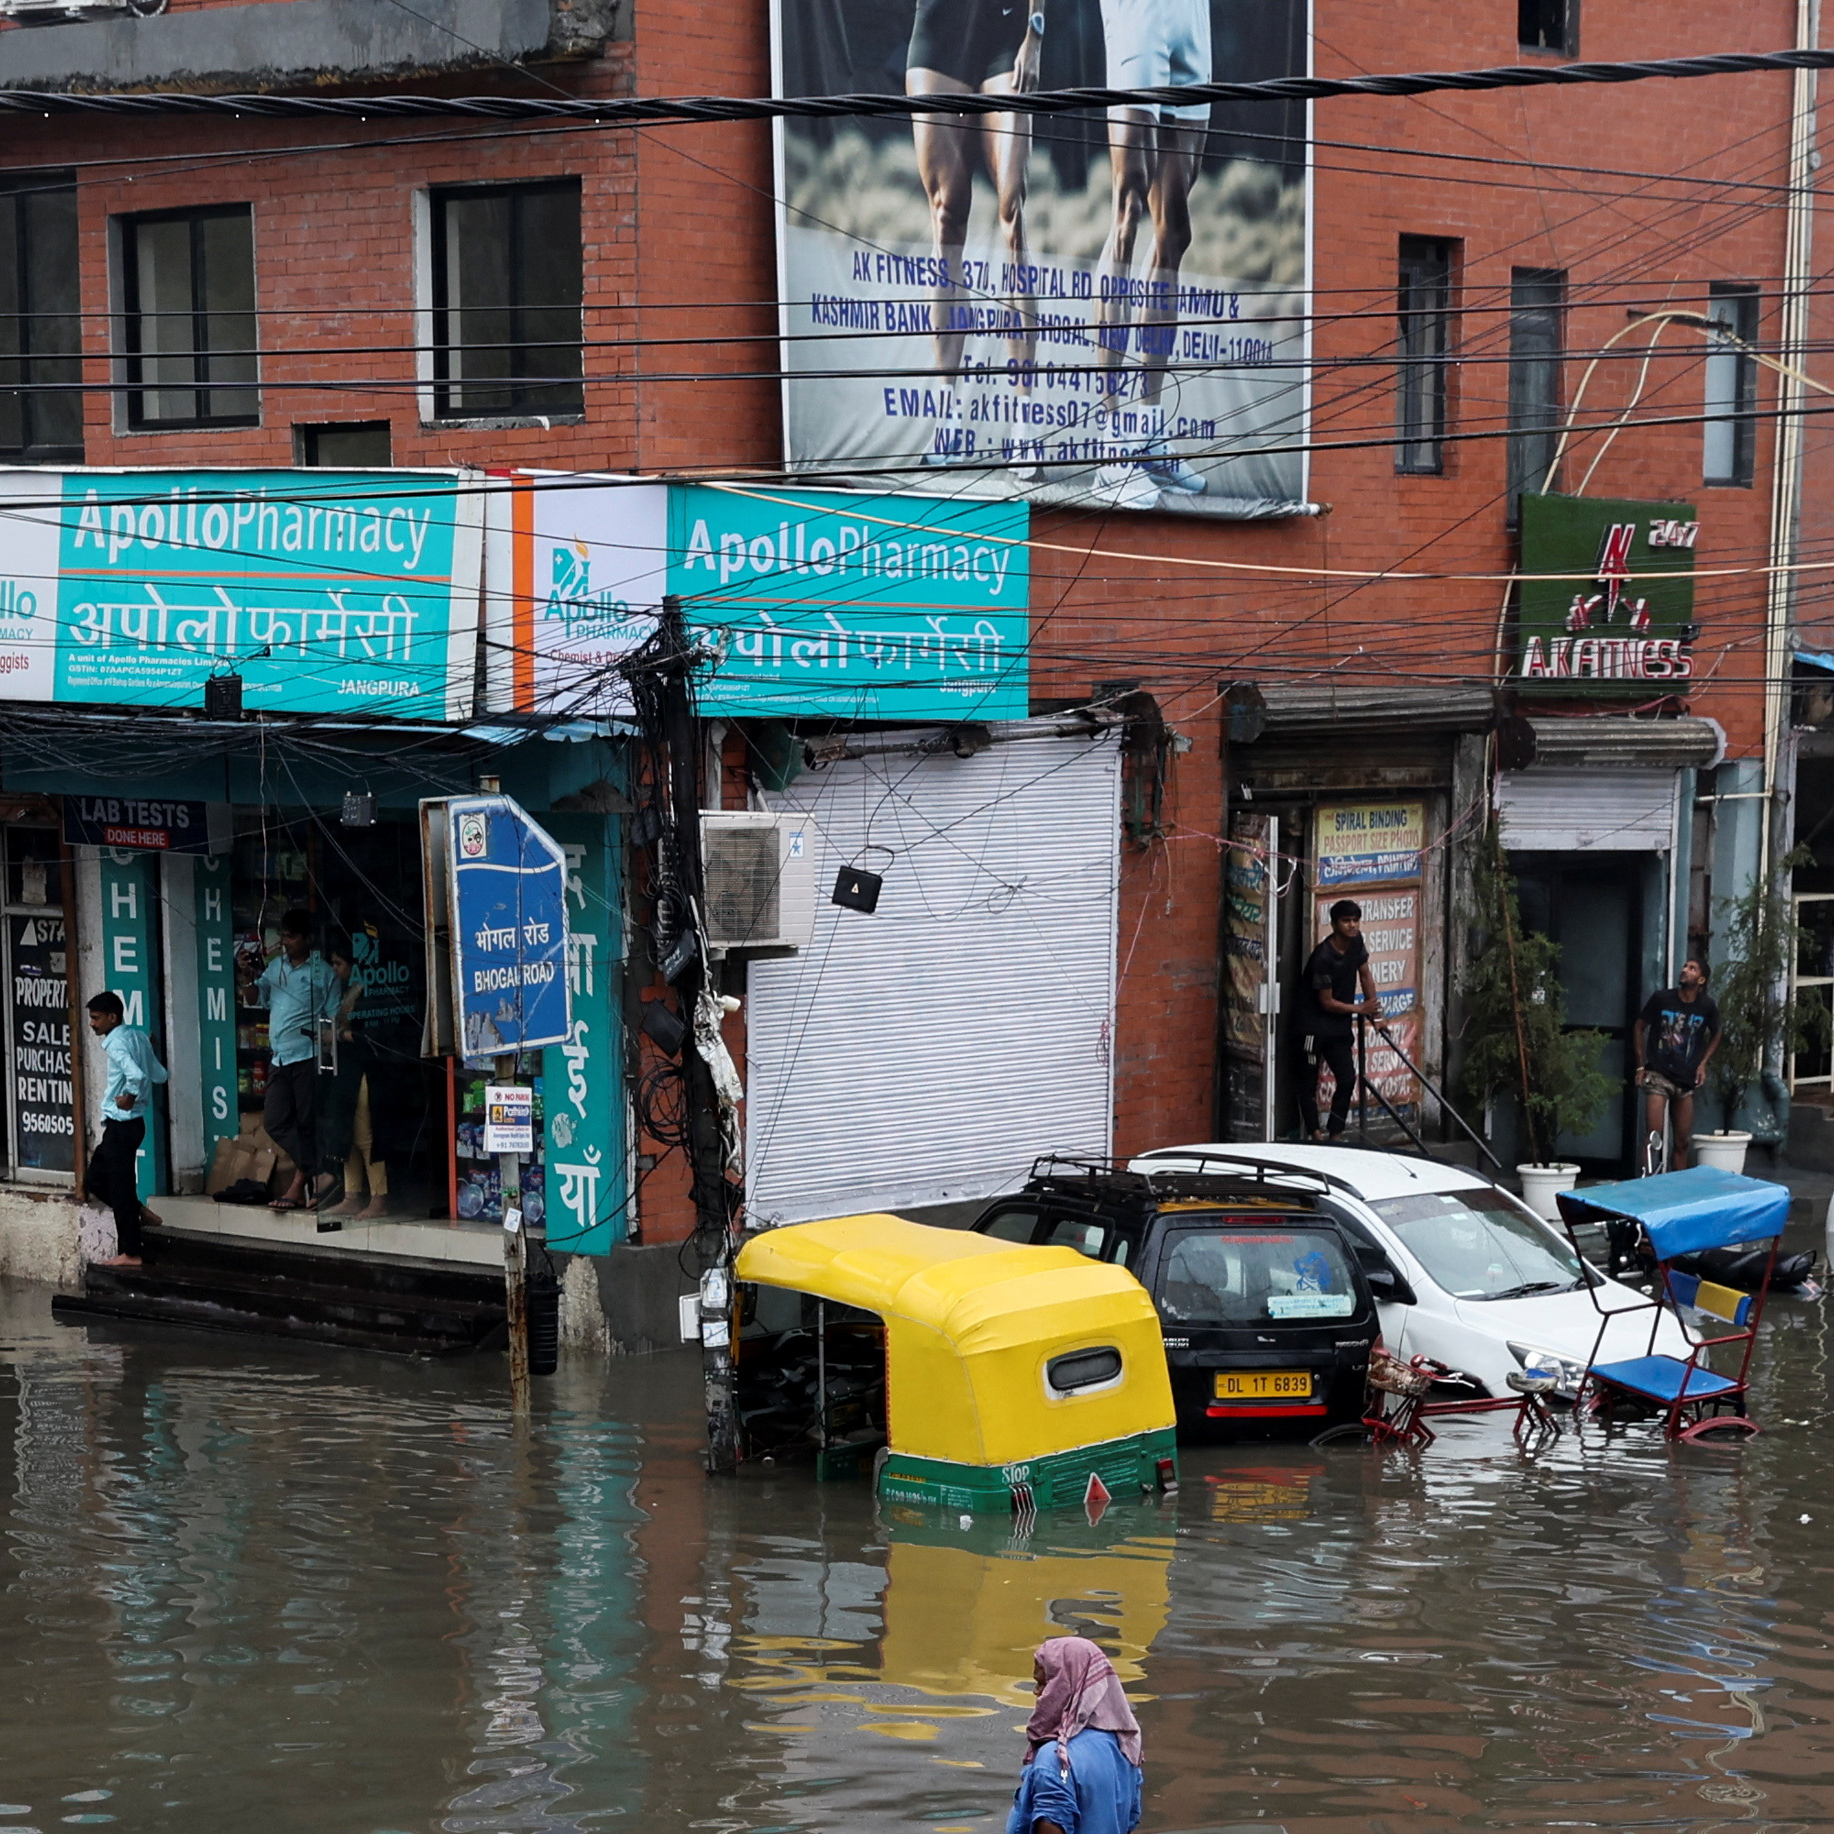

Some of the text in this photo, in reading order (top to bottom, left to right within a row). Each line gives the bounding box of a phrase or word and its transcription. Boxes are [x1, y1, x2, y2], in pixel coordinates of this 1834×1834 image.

[853, 251, 871, 282] AK
[876, 254, 956, 292] FITNESS,
[1002, 263, 1066, 298] HOSPITAL
[1100, 275, 1171, 310] OPPOSITE
[1229, 294, 1239, 318] &
[812, 293, 880, 331] KASHMIR
[884, 387, 1216, 440] EMAIL: akfitness07@gmail.com
[544, 589, 629, 638] Apollo
[576, 625, 659, 640] PHARMACY
[68, 654, 192, 666] A unit of Apollo Pharmacies
[595, 652, 602, 663] &
[1572, 638, 1693, 678] FITNESS
[337, 679, 421, 697] JANGPURA
[81, 797, 190, 829] LAB TESTS
[1335, 809, 1407, 831] SPIRAL BINDING
[107, 827, 166, 847] DONE HERE
[1324, 829, 1419, 853] PASSPORT SIZE PHOTO
[1361, 897, 1413, 923] TRANSFER
[475, 916, 550, 951] भोगल रोड
[1369, 928, 1413, 953] SERVICE
[348, 961, 410, 997] Apollo
[523, 961, 554, 984] ROAD
[17, 1047, 72, 1074] PURCHAS
[18, 1076, 74, 1104] RENTIN
[1227, 1377, 1308, 1393] DL 1T 6839
[1002, 1465, 1030, 1484] STOP
